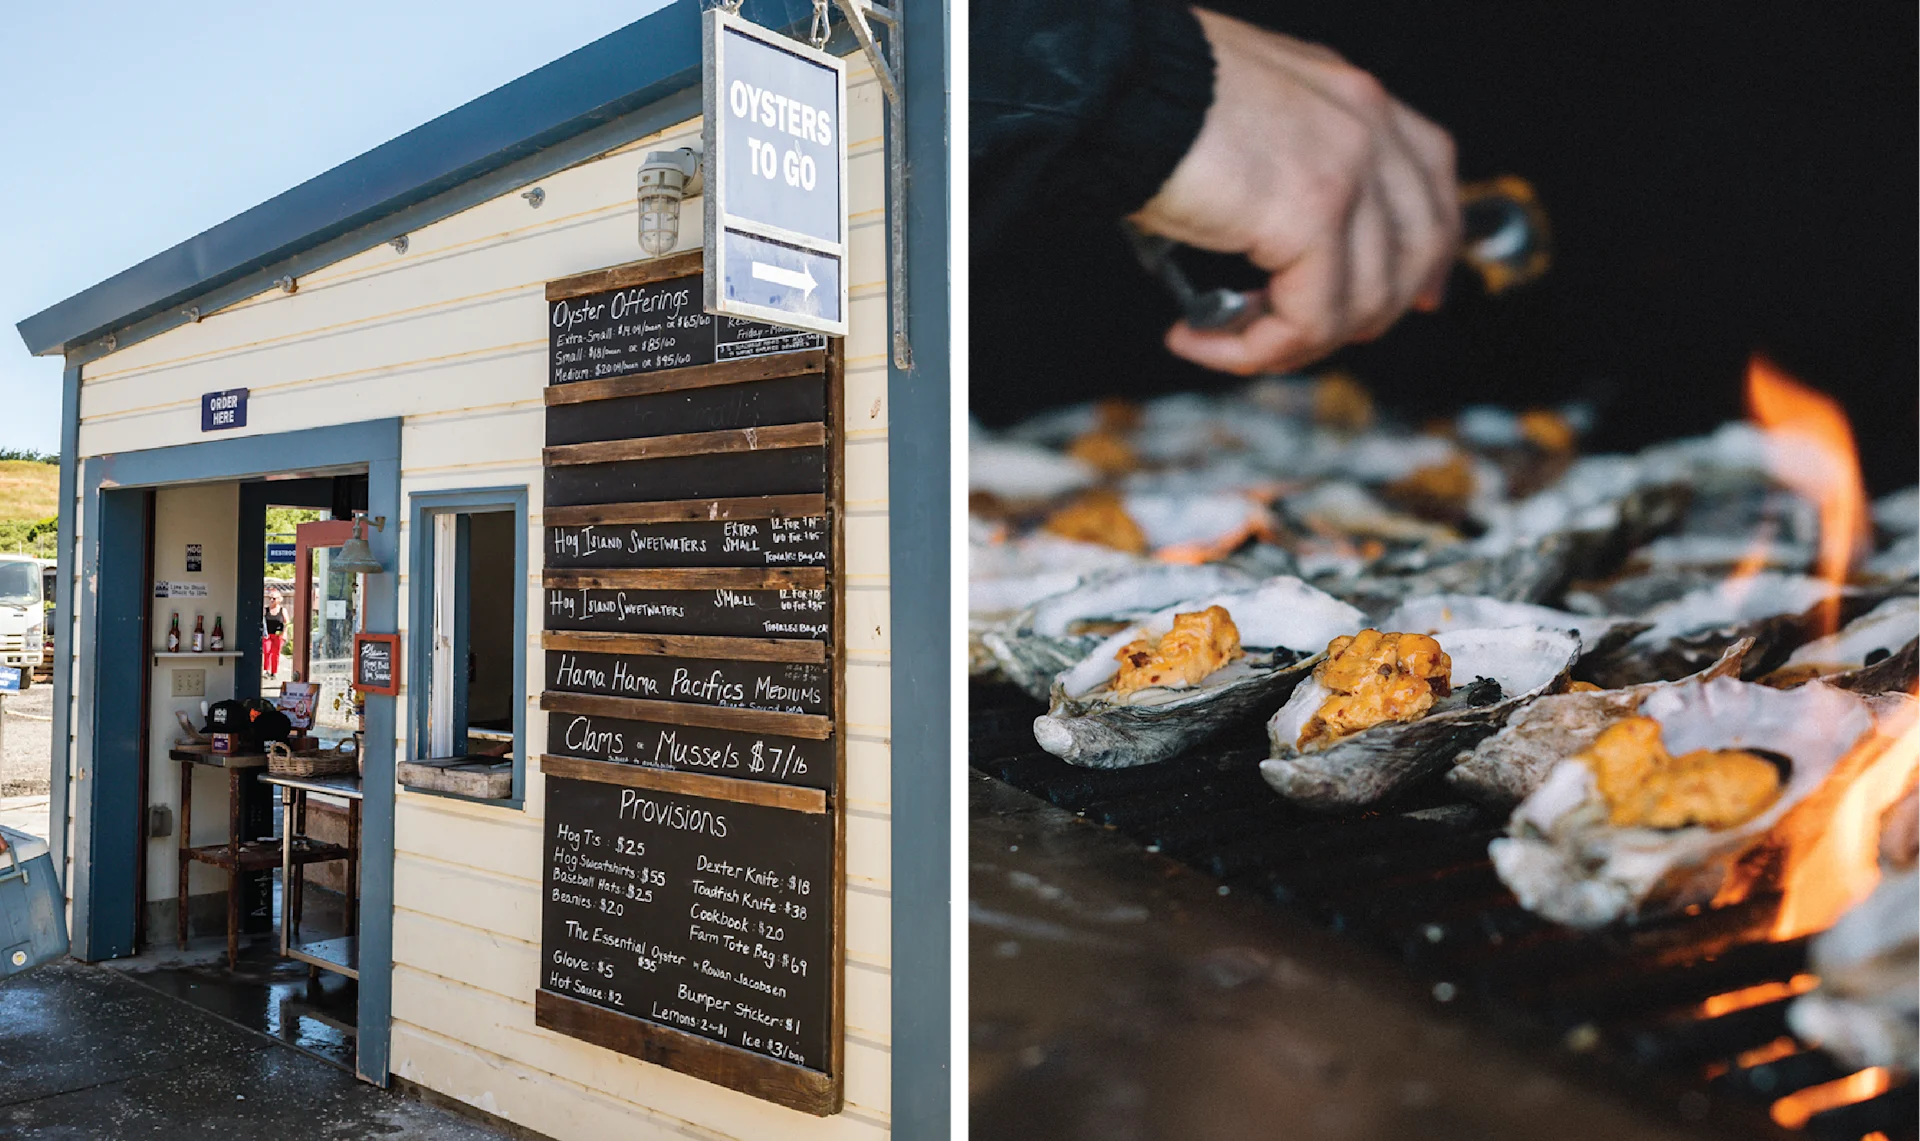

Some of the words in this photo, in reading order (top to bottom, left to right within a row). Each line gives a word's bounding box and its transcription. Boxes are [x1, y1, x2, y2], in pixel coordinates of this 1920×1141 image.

[730, 79, 832, 146] OYSTERS
[748, 136, 777, 180] TO
[783, 149, 816, 191] GO
[552, 300, 605, 331] Oyster
[611, 288, 689, 321] Offerings
[677, 313, 711, 329] $65/60
[736, 326, 763, 340] Friday
[555, 348, 586, 366] Small:
[641, 337, 676, 352] $85/60
[555, 367, 593, 383] Medium:
[656, 353, 691, 367] $95/60
[210, 395, 238, 411] ORDER
[213, 409, 235, 426] HERE
[554, 527, 578, 558] Hog
[723, 521, 759, 538] EXTRA
[550, 589, 575, 619] Hog
[556, 653, 606, 689] Hama
[611, 660, 660, 696] Hama
[670, 668, 744, 701] Pacifics
[565, 715, 624, 754] Clams
[654, 730, 740, 769] Mussels
[619, 788, 727, 838] Provisions
[556, 823, 581, 851] Hog
[615, 836, 645, 856] $25
[553, 846, 578, 872] Hog
[640, 867, 666, 887] $55
[696, 854, 743, 879] Dexter
[786, 875, 811, 895] $18
[552, 867, 595, 888] Baseball
[625, 883, 653, 903] $25
[692, 879, 740, 904] Toadfish
[783, 901, 808, 921] $38
[599, 897, 624, 917] $20
[758, 921, 785, 941] $20
[565, 920, 589, 941] The
[592, 927, 647, 955] Essential
[650, 945, 686, 965] Oyster
[700, 959, 732, 981] Rowan
[733, 972, 787, 998] Jacobsen
[637, 955, 658, 973] $35
[689, 924, 719, 944] Farm
[723, 934, 750, 955] Tote
[781, 953, 808, 977] $69
[597, 960, 615, 979] $5
[549, 969, 572, 990] Hot
[608, 989, 624, 1006] $2
[677, 983, 731, 1012] Bumper
